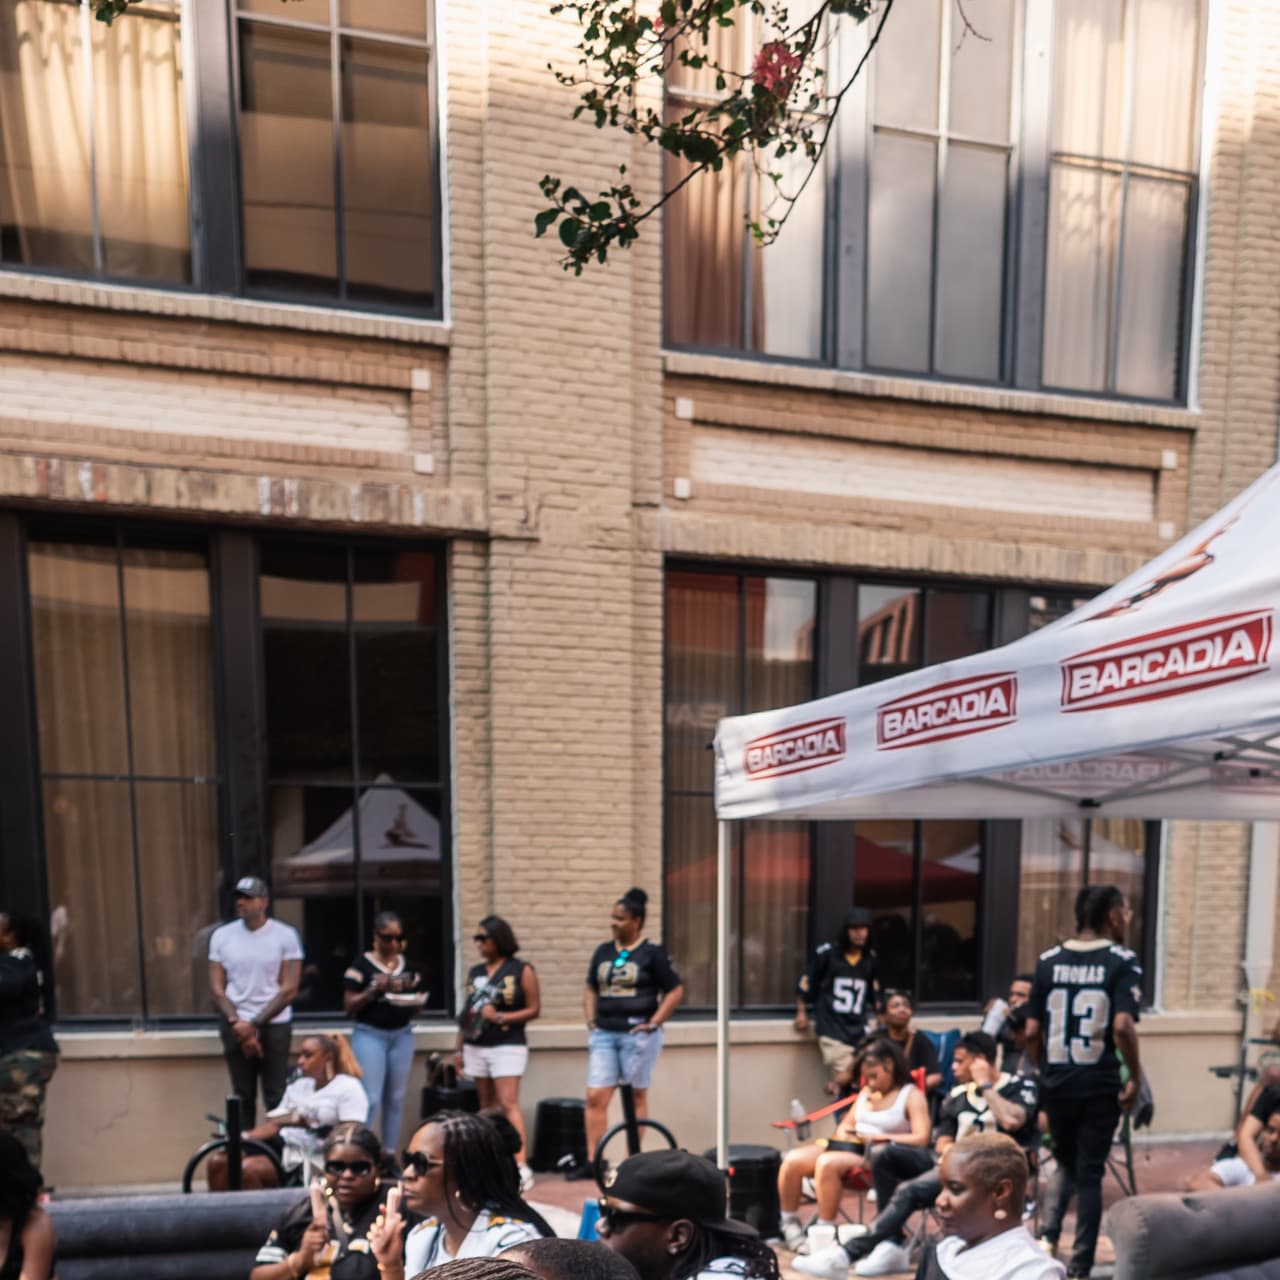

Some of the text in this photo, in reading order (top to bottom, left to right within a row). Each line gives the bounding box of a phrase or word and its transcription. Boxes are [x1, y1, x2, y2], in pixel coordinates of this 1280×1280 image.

[1068, 629, 1257, 699] BARCADIA
[881, 686, 1007, 739] BARCADIA
[748, 729, 841, 774] BARCADIA
[597, 961, 639, 998] 12
[832, 977, 868, 1015] 57
[1052, 964, 1106, 985] THOMAS
[1046, 988, 1111, 1066] 13
